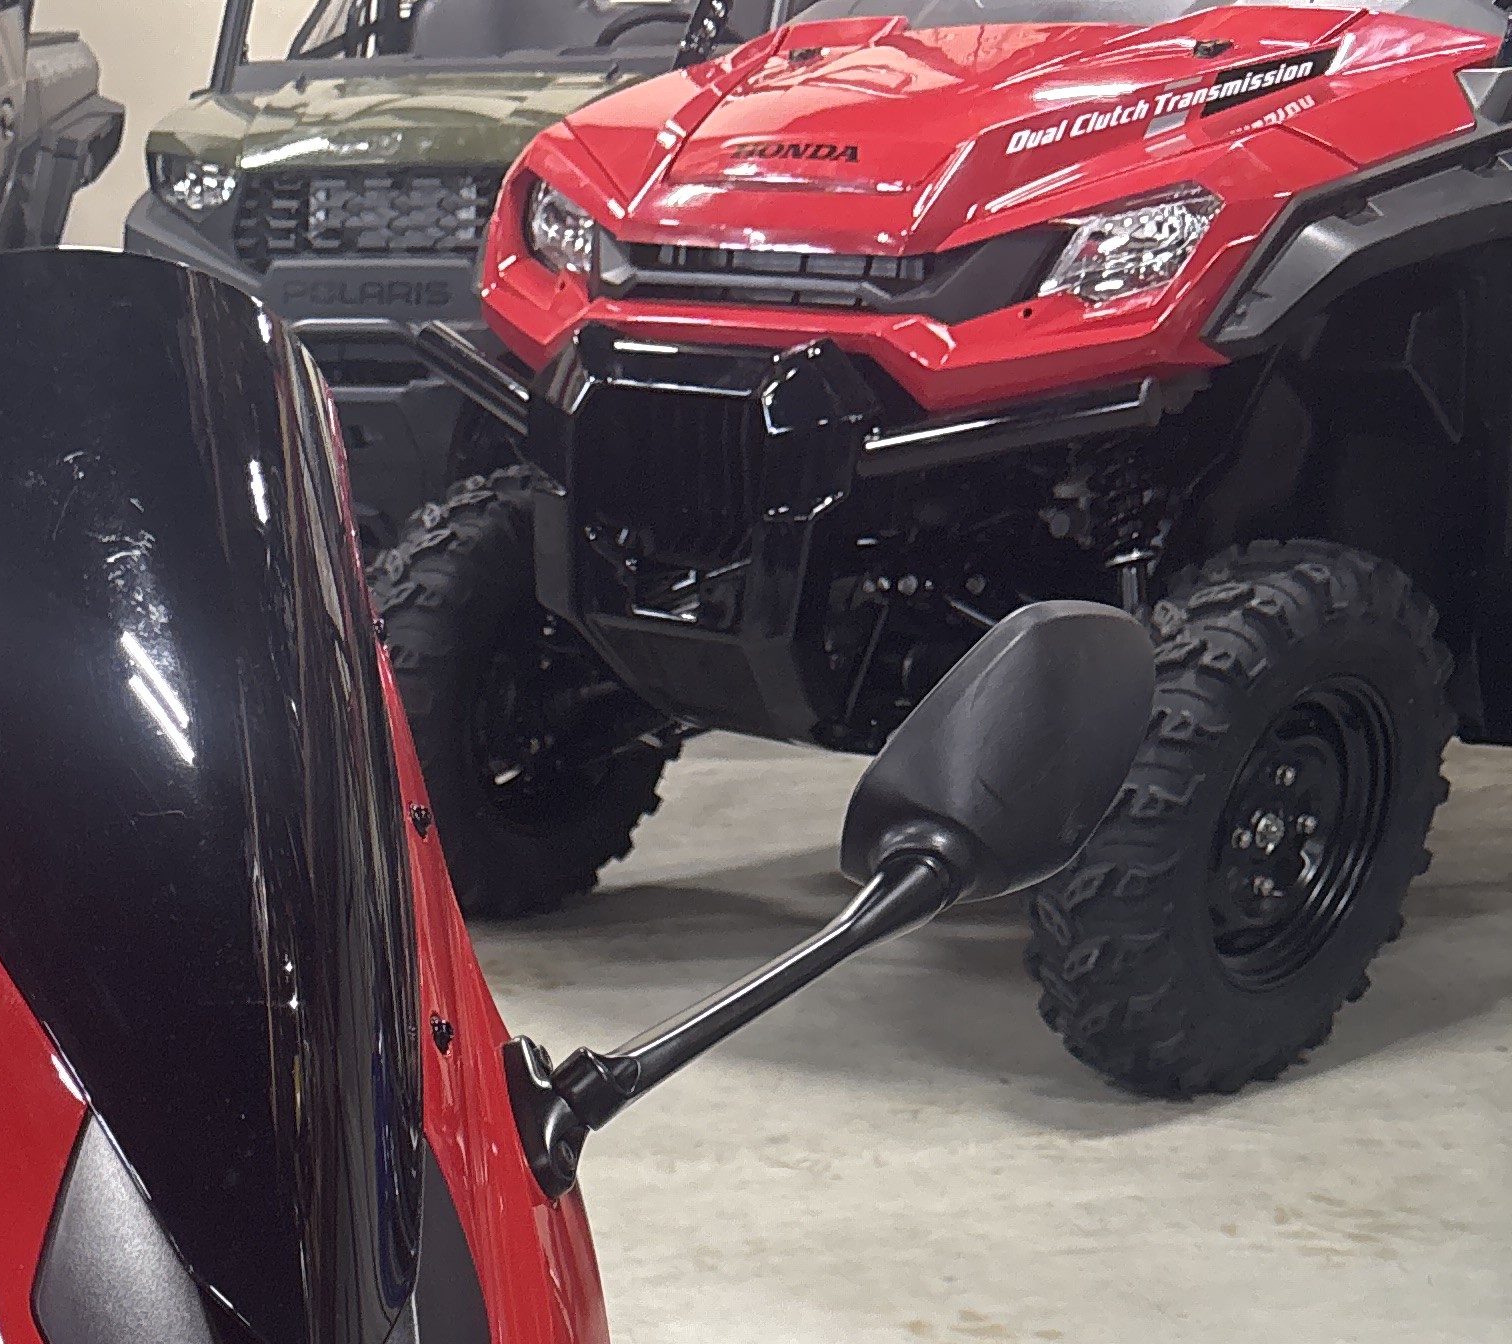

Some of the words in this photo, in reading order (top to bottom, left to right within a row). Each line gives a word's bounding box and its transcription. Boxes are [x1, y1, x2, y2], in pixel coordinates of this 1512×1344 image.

[1006, 121, 1065, 154] Dual
[1069, 99, 1150, 136] Clutch
[1152, 61, 1314, 115] Transmission
[730, 141, 860, 163] HONDA
[282, 279, 454, 306] POLARIS
